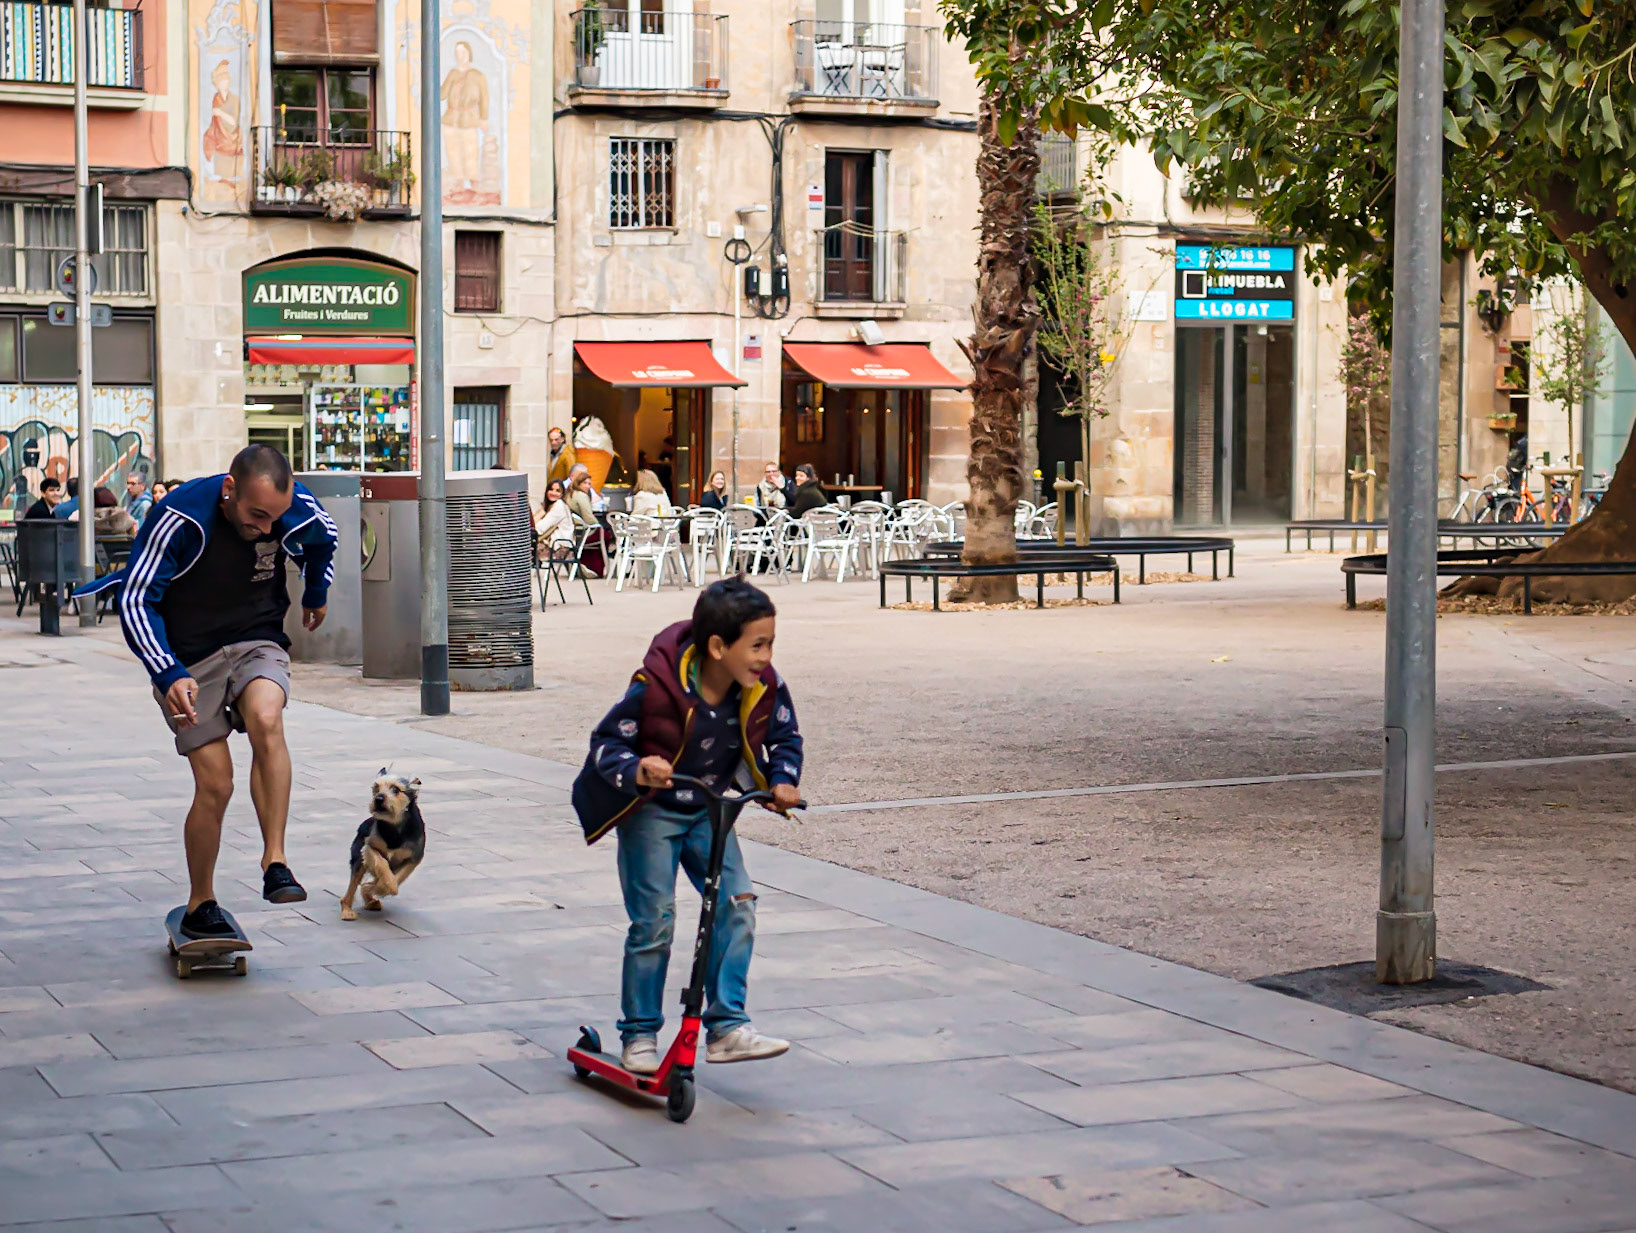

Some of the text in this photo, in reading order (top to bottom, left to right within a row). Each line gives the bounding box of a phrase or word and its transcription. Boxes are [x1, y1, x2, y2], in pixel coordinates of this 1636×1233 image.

[1208, 275, 1286, 288] IMUEBLA
[253, 282, 399, 305] ALIMENTACIÓ
[284, 309, 318, 320] Fruites
[325, 309, 369, 320] Verdures
[1199, 302, 1270, 316] LLOGAT
